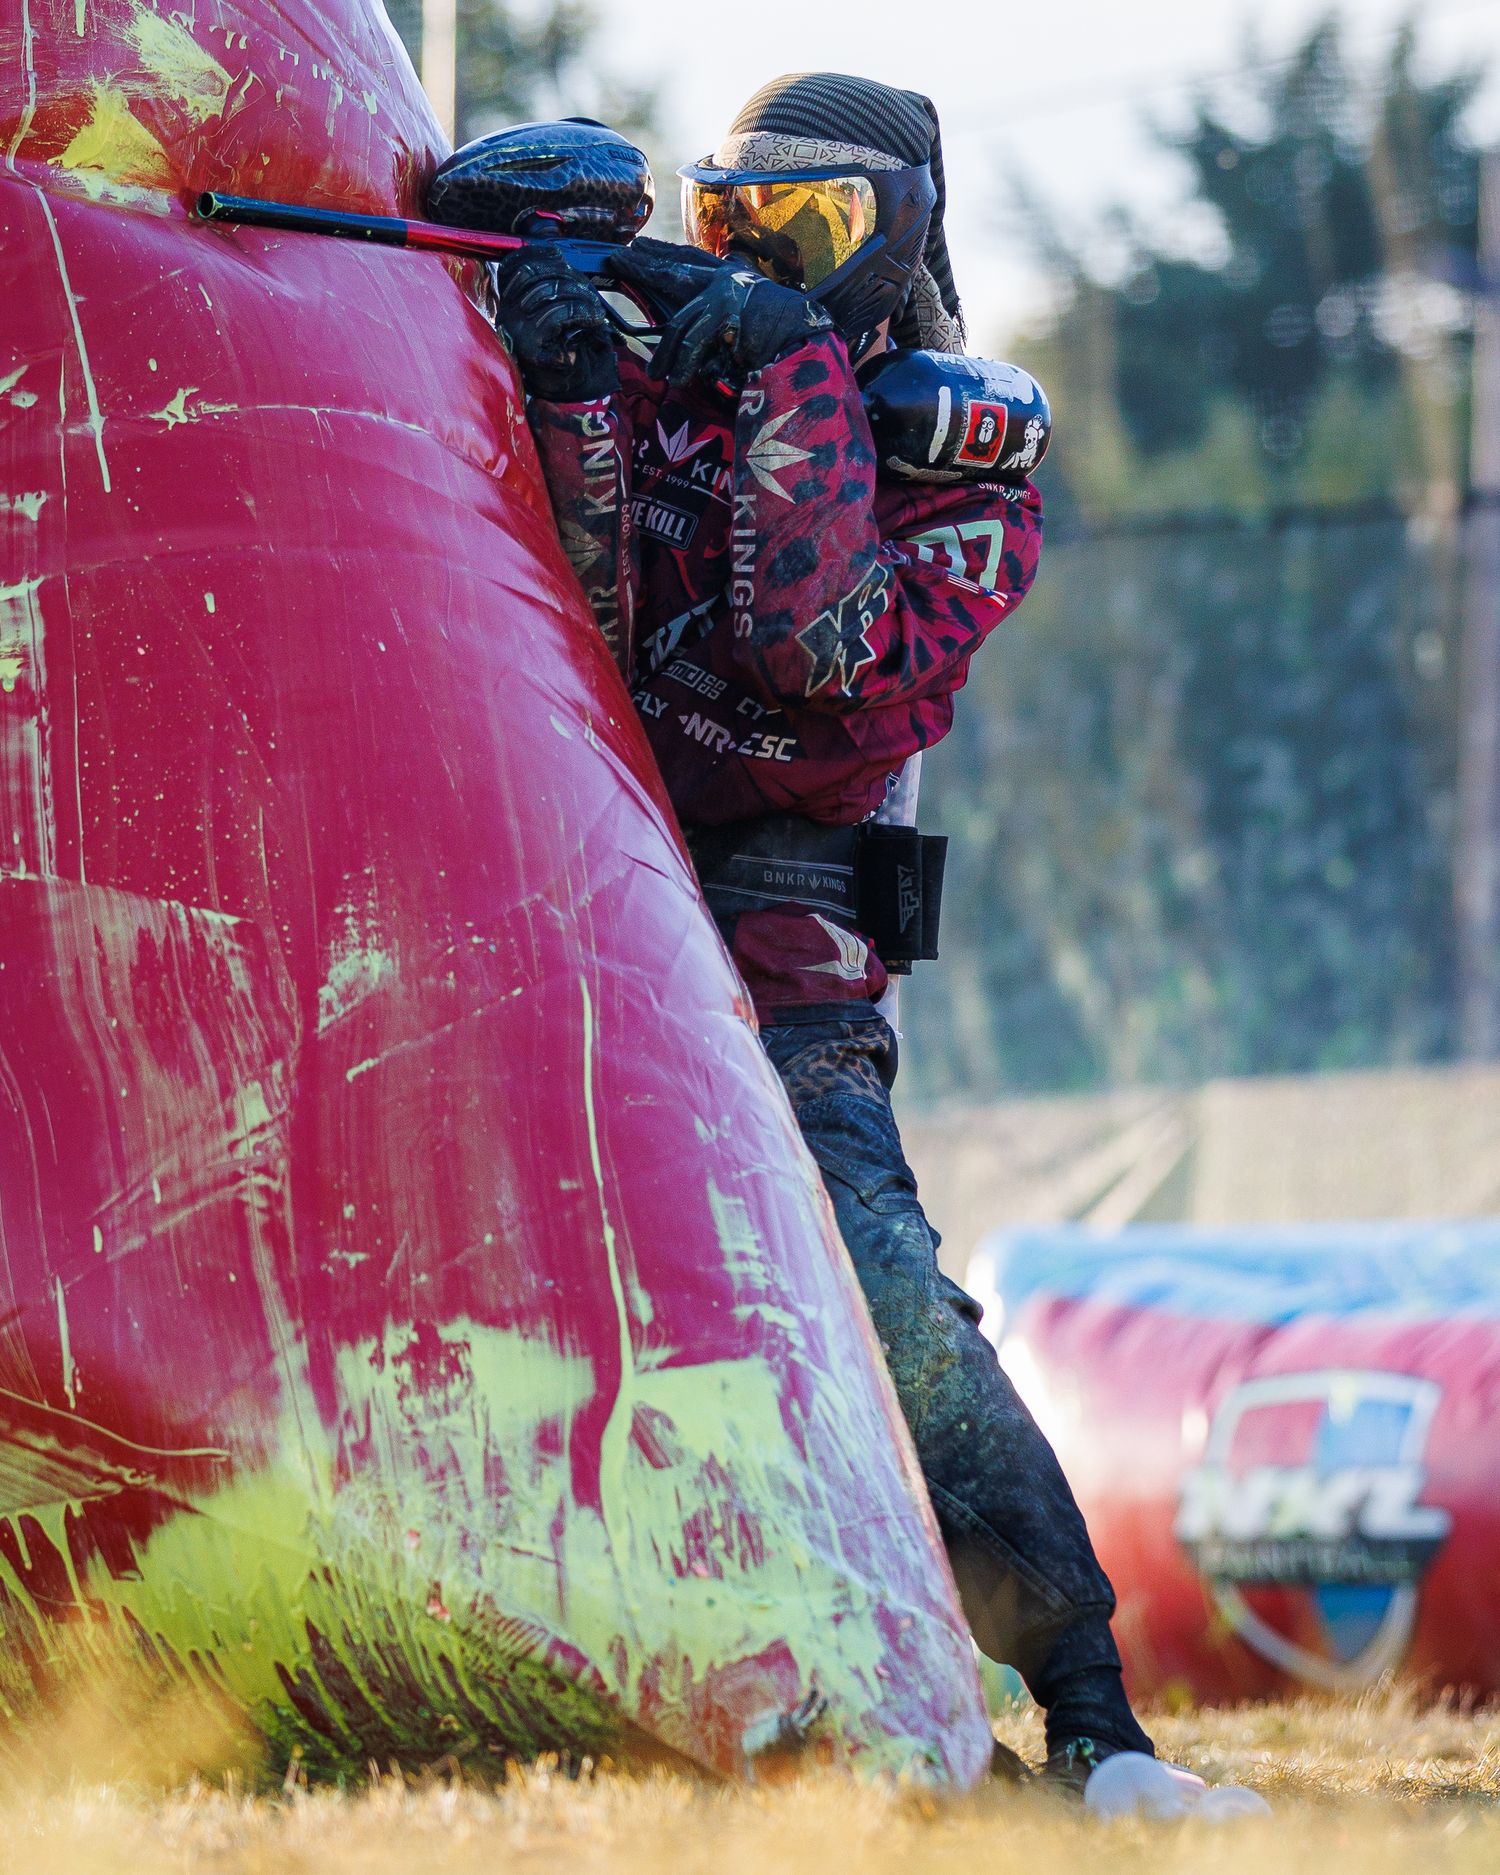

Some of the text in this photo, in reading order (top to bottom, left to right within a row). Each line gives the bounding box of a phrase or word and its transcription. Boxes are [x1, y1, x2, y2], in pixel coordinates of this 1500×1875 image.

[665, 474, 690, 489] 1999
[644, 505, 688, 542] KILL
[733, 494, 757, 638] KINGS
[763, 870, 847, 893] BNKR KINGS
